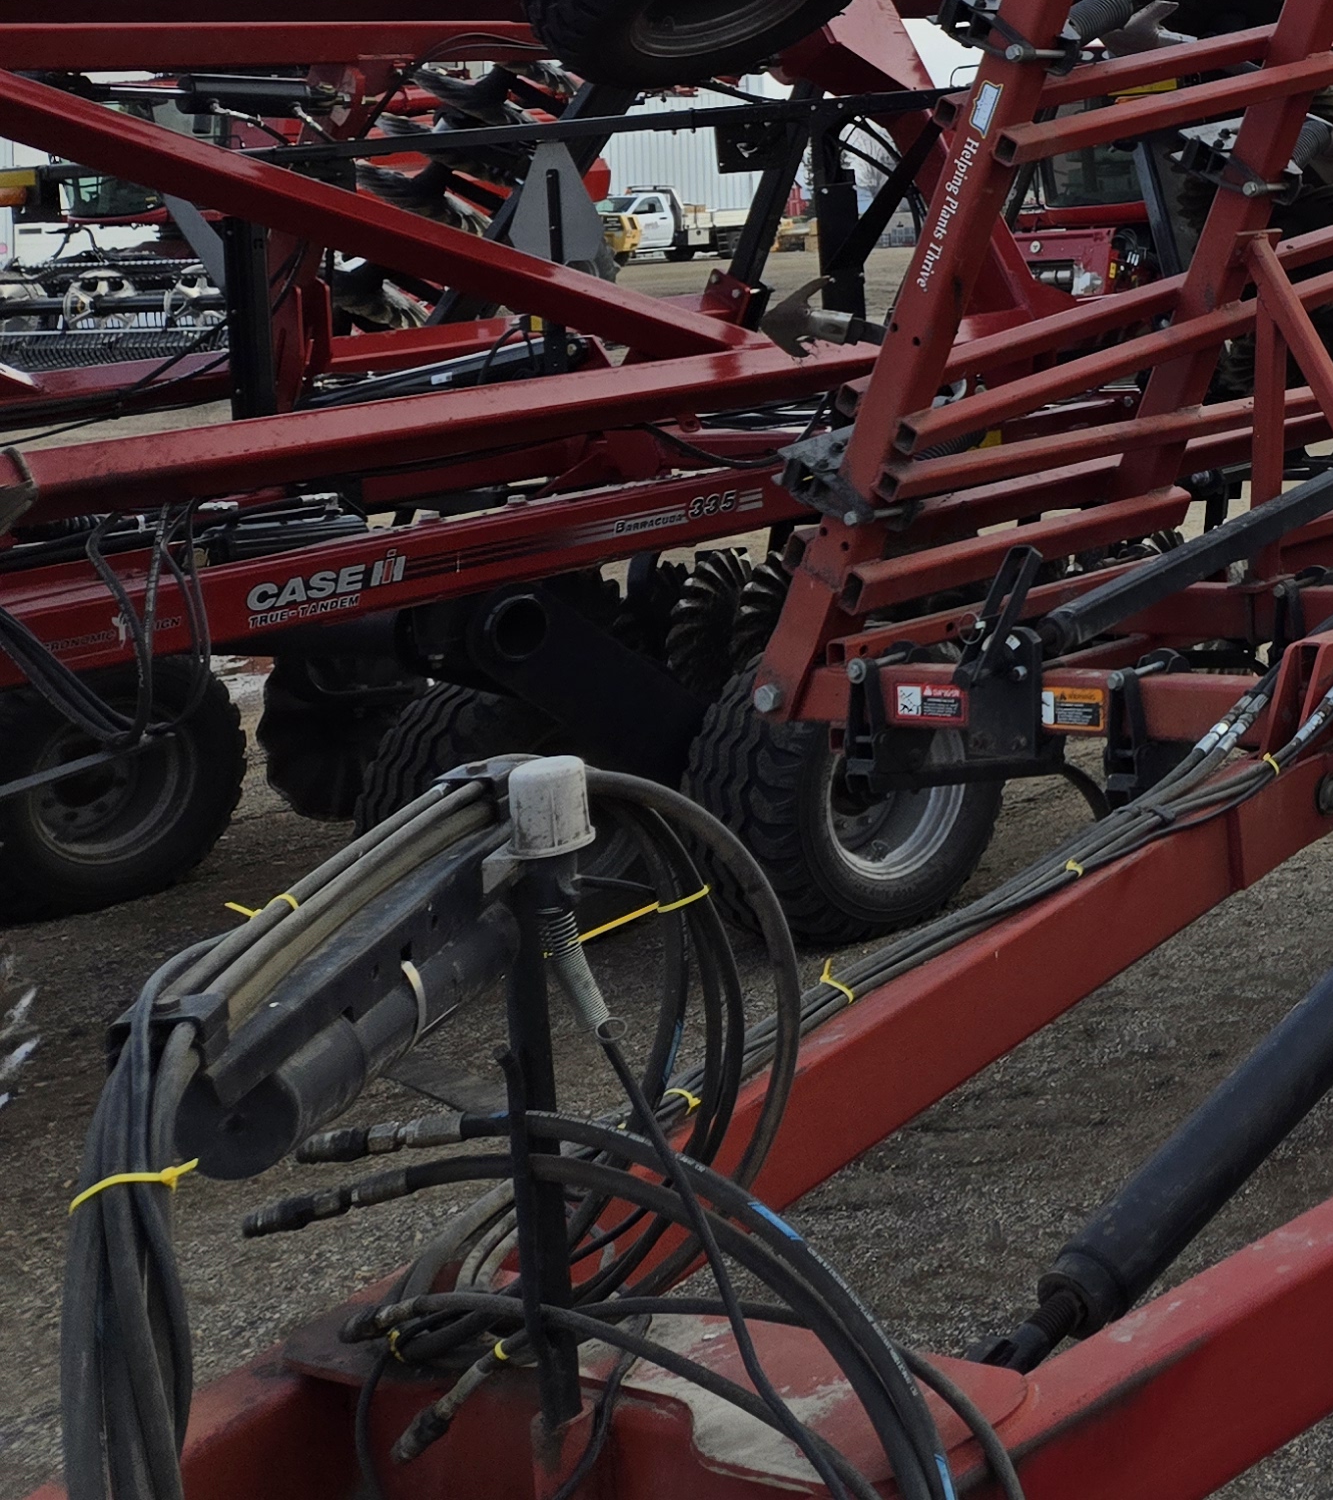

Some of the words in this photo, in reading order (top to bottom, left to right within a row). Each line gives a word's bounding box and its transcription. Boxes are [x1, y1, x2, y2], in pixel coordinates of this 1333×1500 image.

[945, 136, 980, 195] Helping
[933, 195, 959, 240] Plants
[916, 242, 943, 289] Thrive
[688, 489, 738, 518] 335
[246, 563, 366, 611] CASE
[249, 592, 361, 629] TRUE-TANDEM
